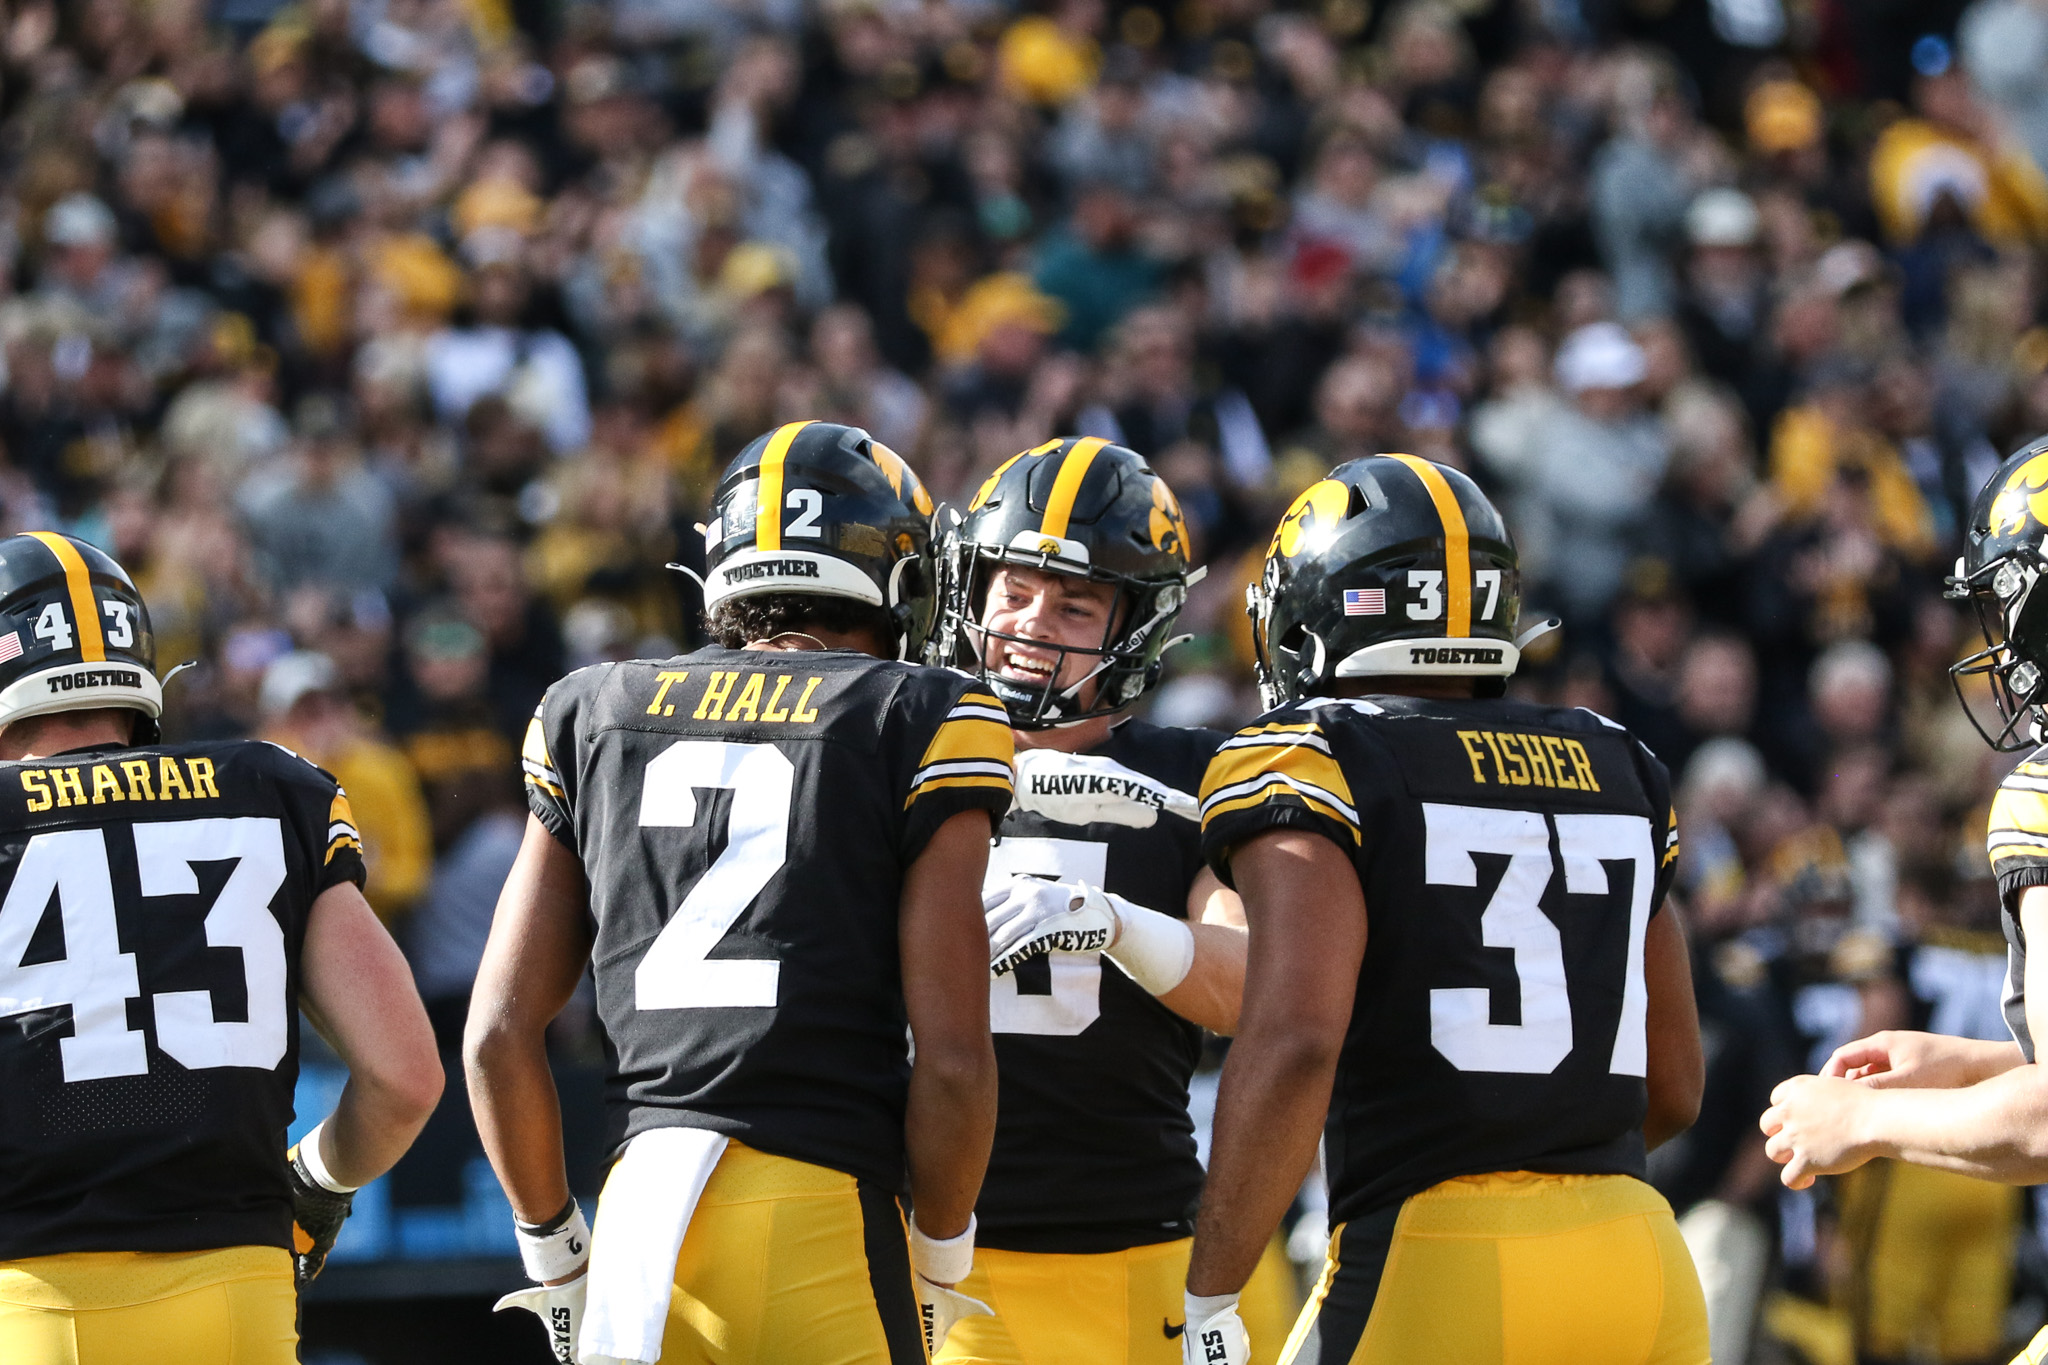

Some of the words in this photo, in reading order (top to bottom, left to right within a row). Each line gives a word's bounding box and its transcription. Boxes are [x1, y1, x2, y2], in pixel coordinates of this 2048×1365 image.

[785, 488, 822, 538] 2
[723, 559, 820, 586] TOGETHER
[46, 669, 143, 693] TOGETHER
[1410, 648, 1503, 665] TOGETHER
[646, 671, 689, 717] T.
[692, 671, 824, 723] HALL
[20, 756, 220, 813] SHARAR
[1456, 730, 1602, 792] FISHER
[1031, 774, 1167, 810] HAWKEYES
[635, 740, 796, 1011] 2
[0, 817, 288, 1083] 43
[991, 928, 1108, 977] HAWKEYES
[1422, 802, 1656, 1079] 37
[1201, 1329, 1229, 1365] ES
